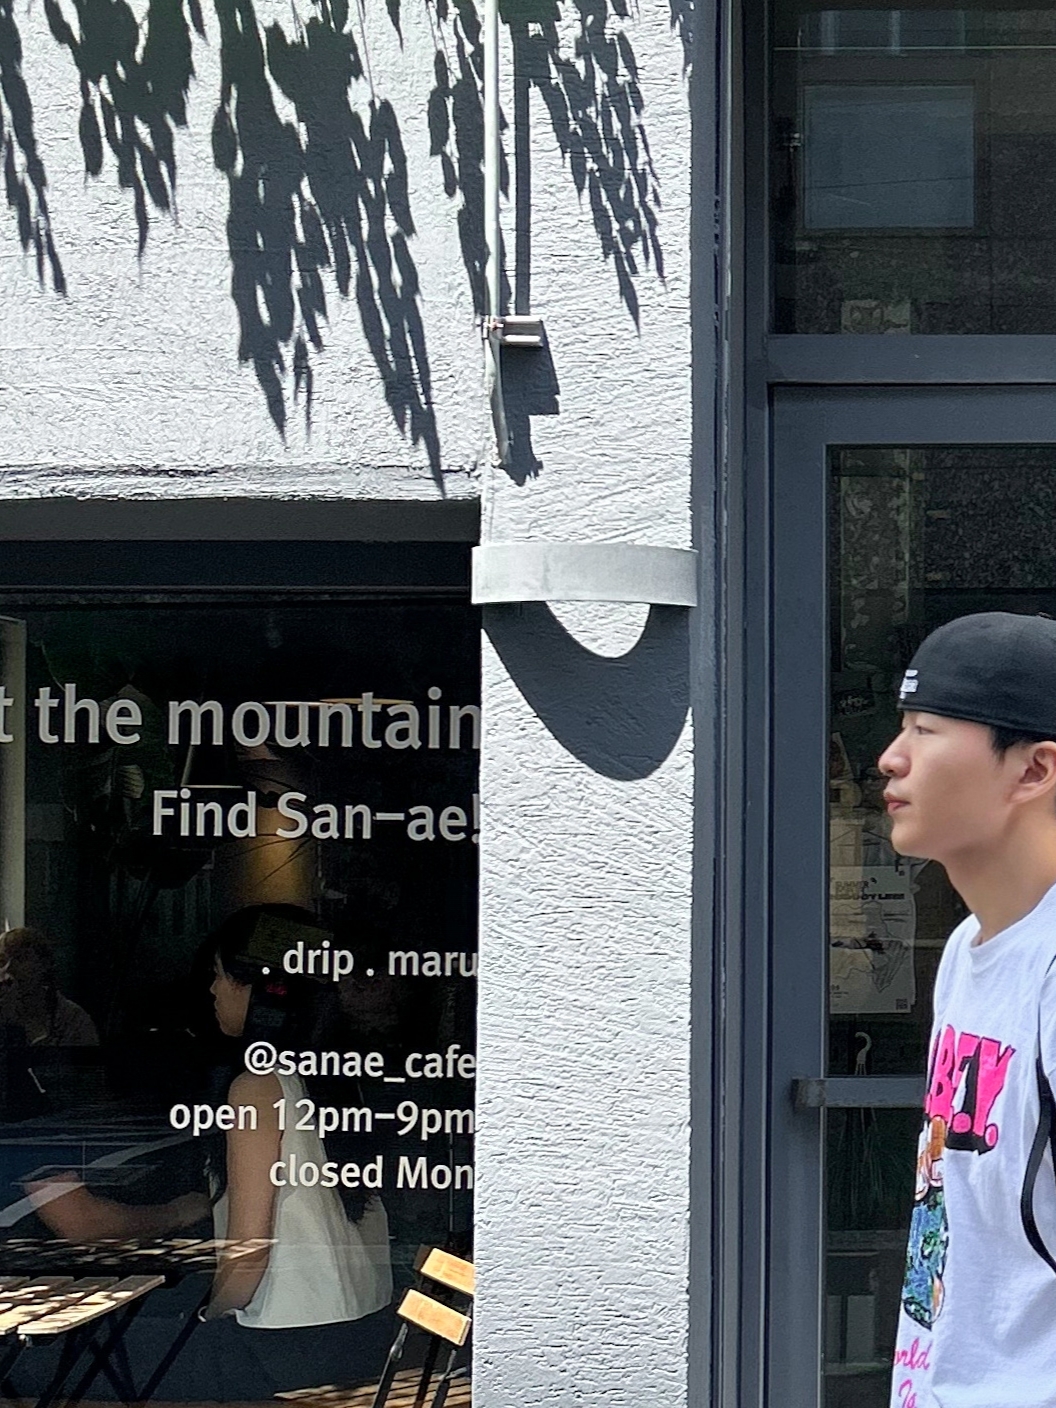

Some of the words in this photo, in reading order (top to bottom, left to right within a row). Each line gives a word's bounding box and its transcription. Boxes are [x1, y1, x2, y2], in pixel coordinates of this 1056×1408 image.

[34, 683, 142, 745] the
[168, 686, 481, 750] mountain
[152, 788, 256, 838] Find
[283, 940, 354, 982] drip
[388, 950, 478, 977] maru
[244, 1041, 476, 1083] @sanae_cafe
[169, 1103, 257, 1138] open
[272, 1100, 475, 1142] 12pm-9pm
[269, 1155, 383, 1189] closed
[396, 1155, 474, 1191] Mon
